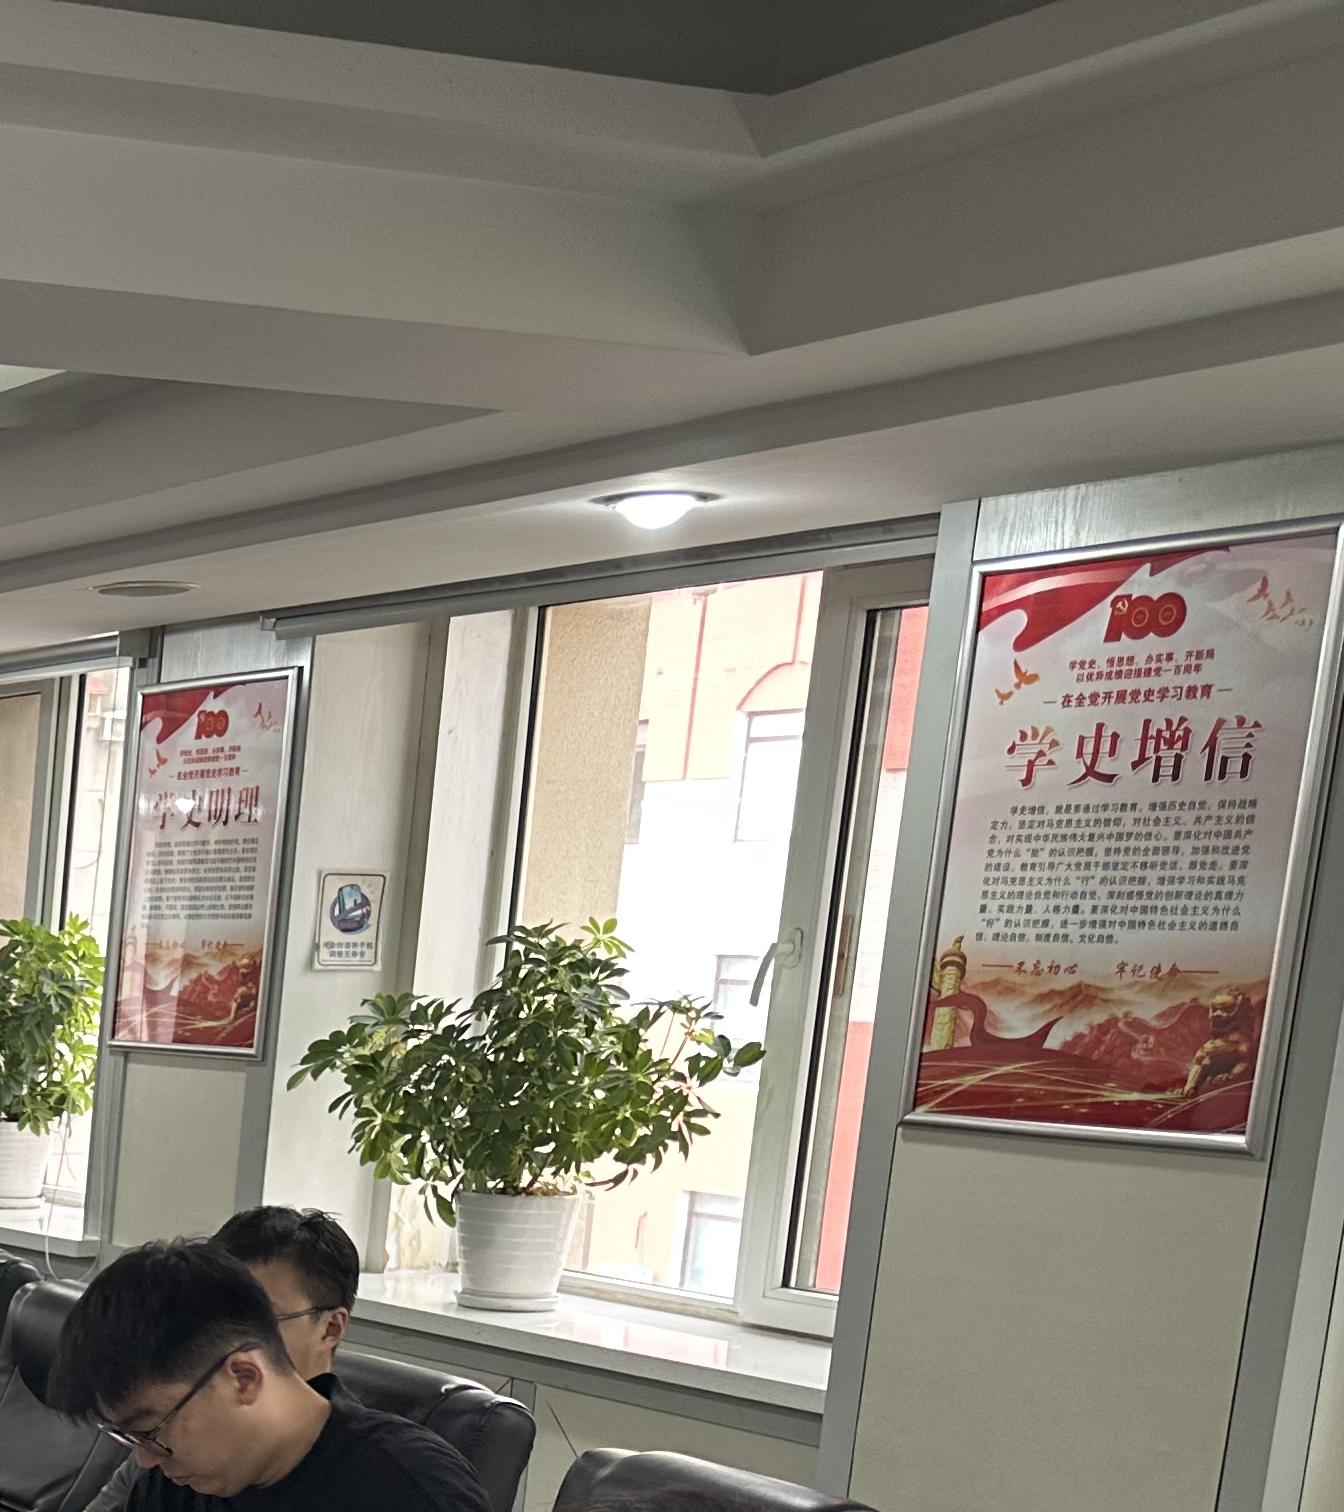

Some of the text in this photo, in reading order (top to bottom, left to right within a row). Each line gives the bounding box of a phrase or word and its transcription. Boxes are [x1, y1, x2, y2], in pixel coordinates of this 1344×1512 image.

[1103, 591, 1187, 643] 100
[1060, 683, 1214, 709] 在全党开展党史学习教育
[1004, 714, 1263, 788] 学史增信
